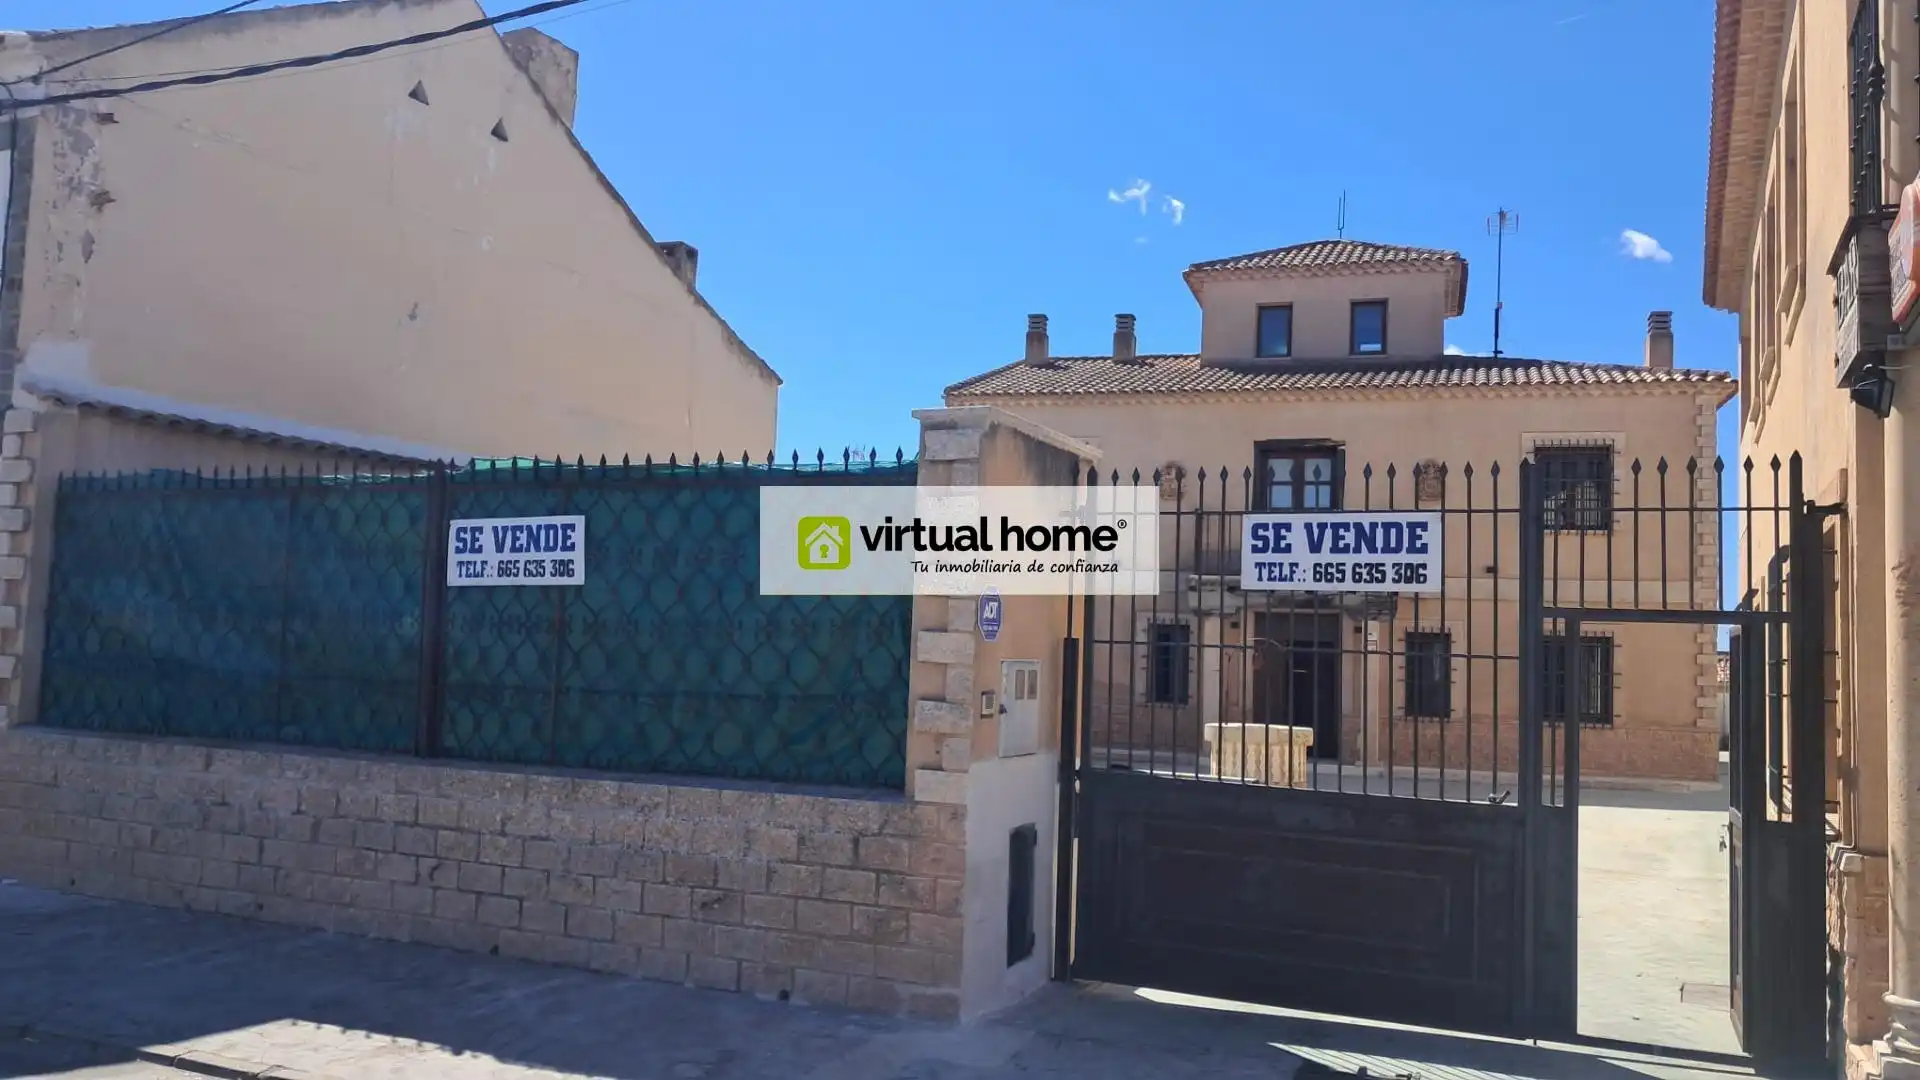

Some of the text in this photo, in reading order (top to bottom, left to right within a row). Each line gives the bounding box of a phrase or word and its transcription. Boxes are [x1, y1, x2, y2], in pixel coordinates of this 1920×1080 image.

[454, 523, 576, 554] SE VENDE
[1250, 521, 1429, 554] SE VENDE
[456, 559, 575, 578] TELF.: 665 635 306
[1254, 561, 1428, 584] TELF.: 665 635 306
[983, 601, 999, 619] ADT
